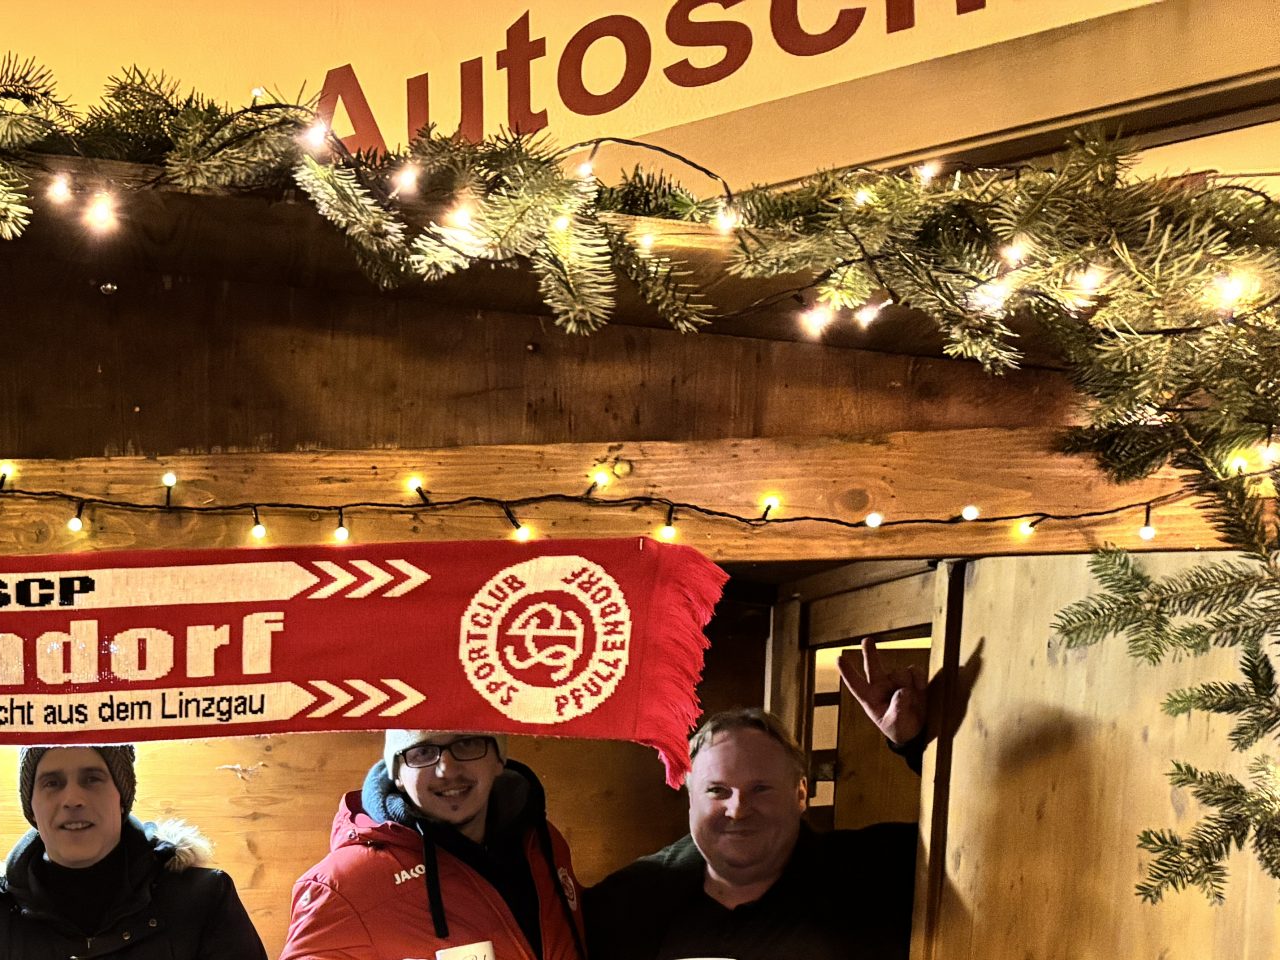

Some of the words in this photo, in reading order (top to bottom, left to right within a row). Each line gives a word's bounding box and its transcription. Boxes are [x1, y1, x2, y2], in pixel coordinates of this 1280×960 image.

[315, 0, 987, 161] Autosc
[43, 701, 88, 725] aus
[98, 694, 152, 723] dem
[161, 692, 265, 722] Linzgau
[466, 574, 526, 706] SPORTCLUB
[554, 567, 626, 716] PFULLENDORF
